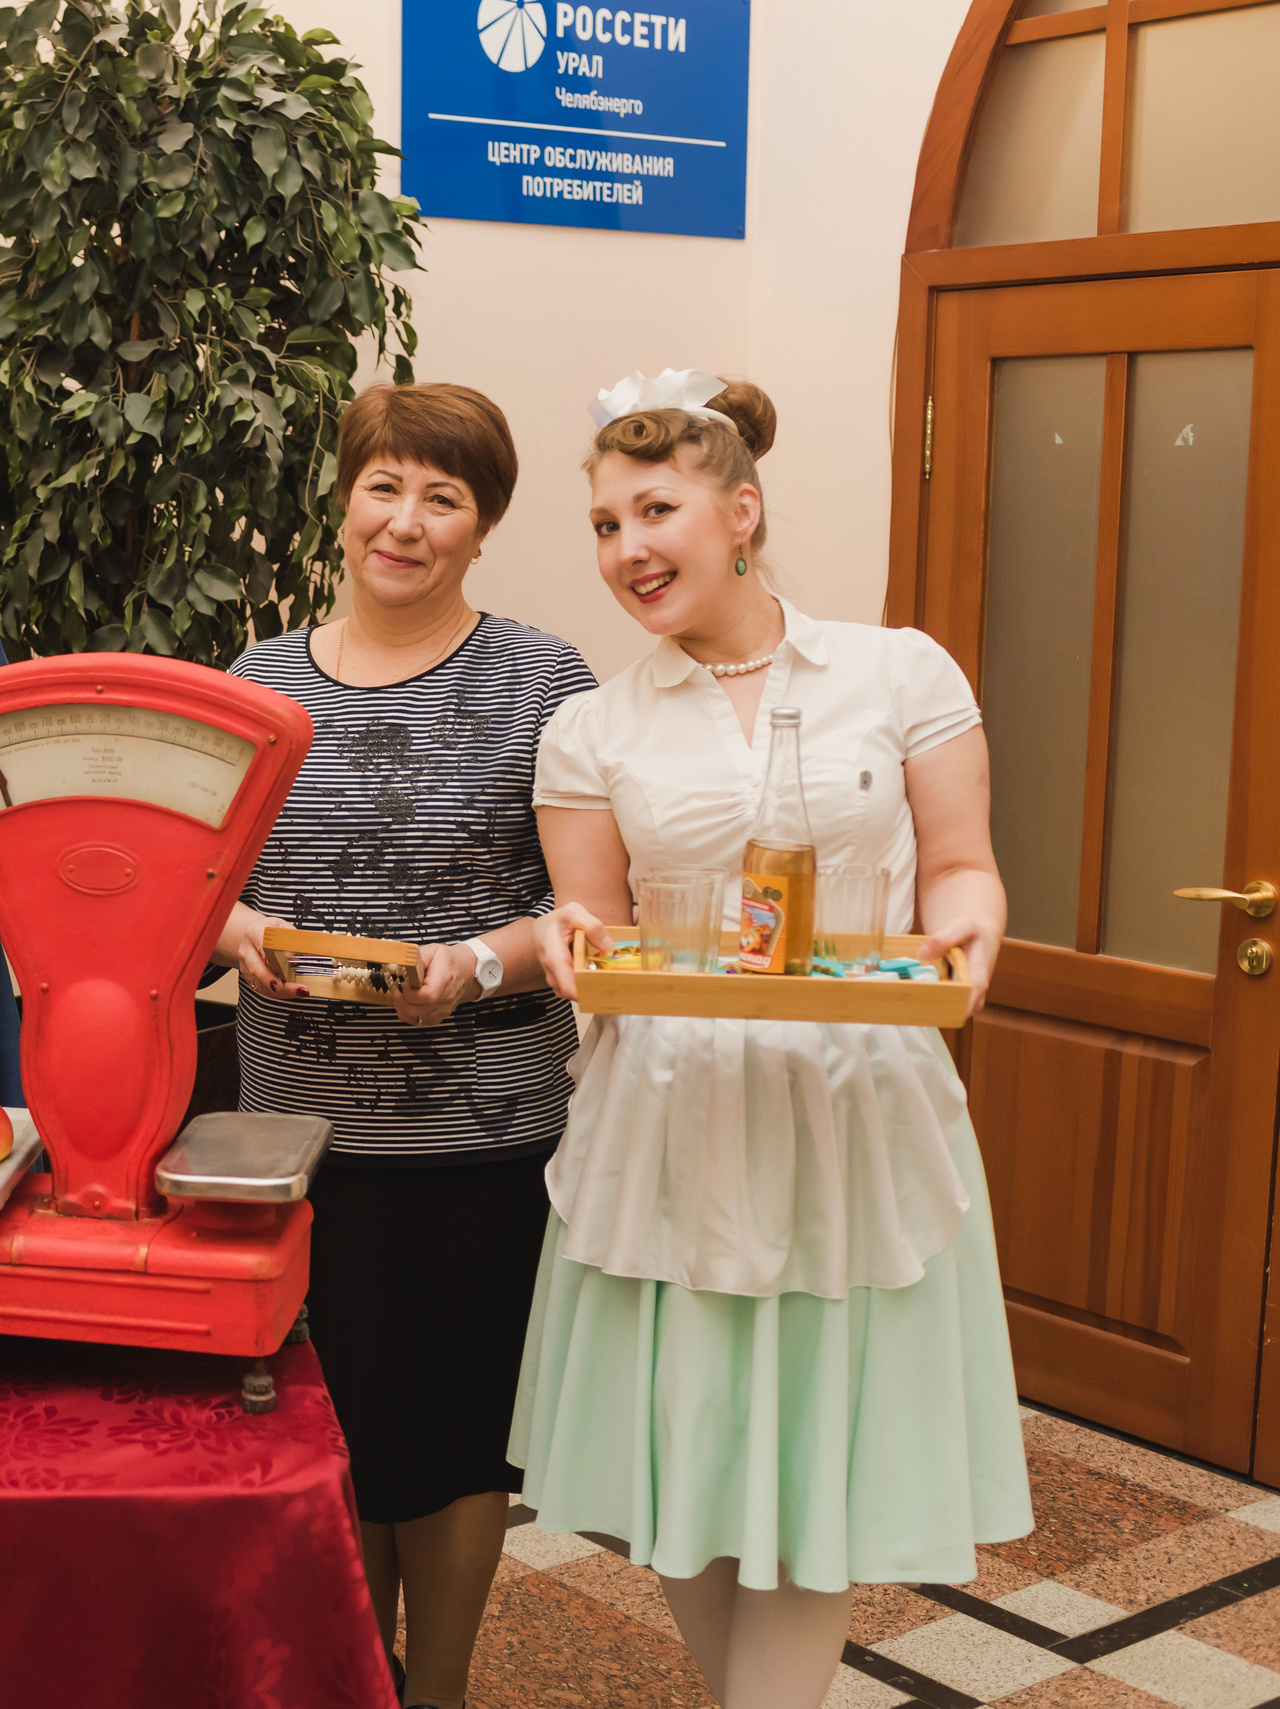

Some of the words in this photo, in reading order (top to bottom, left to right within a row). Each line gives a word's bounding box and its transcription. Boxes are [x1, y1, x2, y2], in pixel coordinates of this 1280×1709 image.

[556, 2, 687, 53] РОССЕТИ
[556, 50, 604, 79] УРАЛ
[555, 86, 644, 118] Челябэнерго
[487, 141, 541, 166] ЦЕНТР
[544, 146, 675, 178] ОБСЛУЖИВАНИЯ
[522, 174, 643, 206] ПОТРЕБИТЕЛЕЙ
